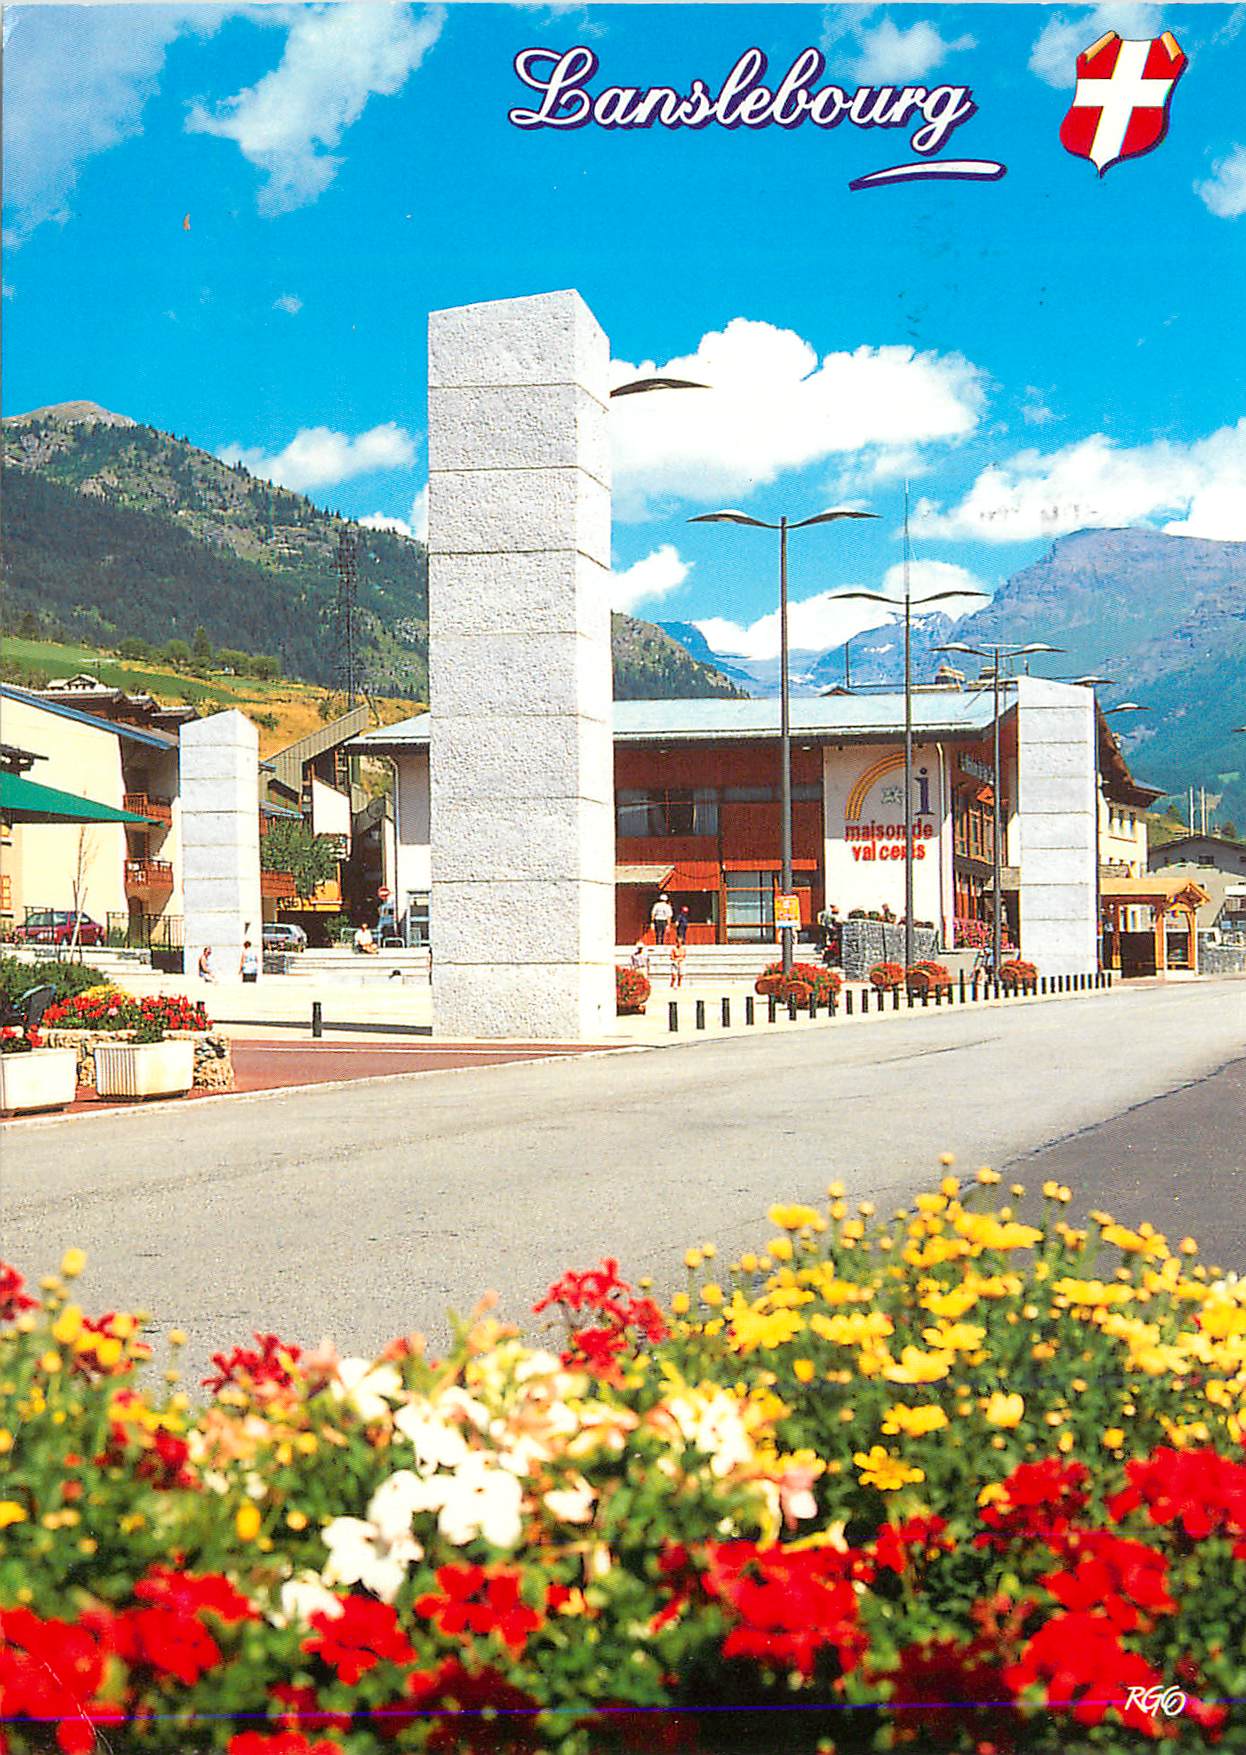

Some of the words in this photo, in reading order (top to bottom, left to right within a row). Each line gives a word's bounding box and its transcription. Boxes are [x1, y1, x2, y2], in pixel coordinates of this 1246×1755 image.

[844, 820, 907, 842] maison
[911, 818, 933, 840] de
[852, 841, 876, 861] val
